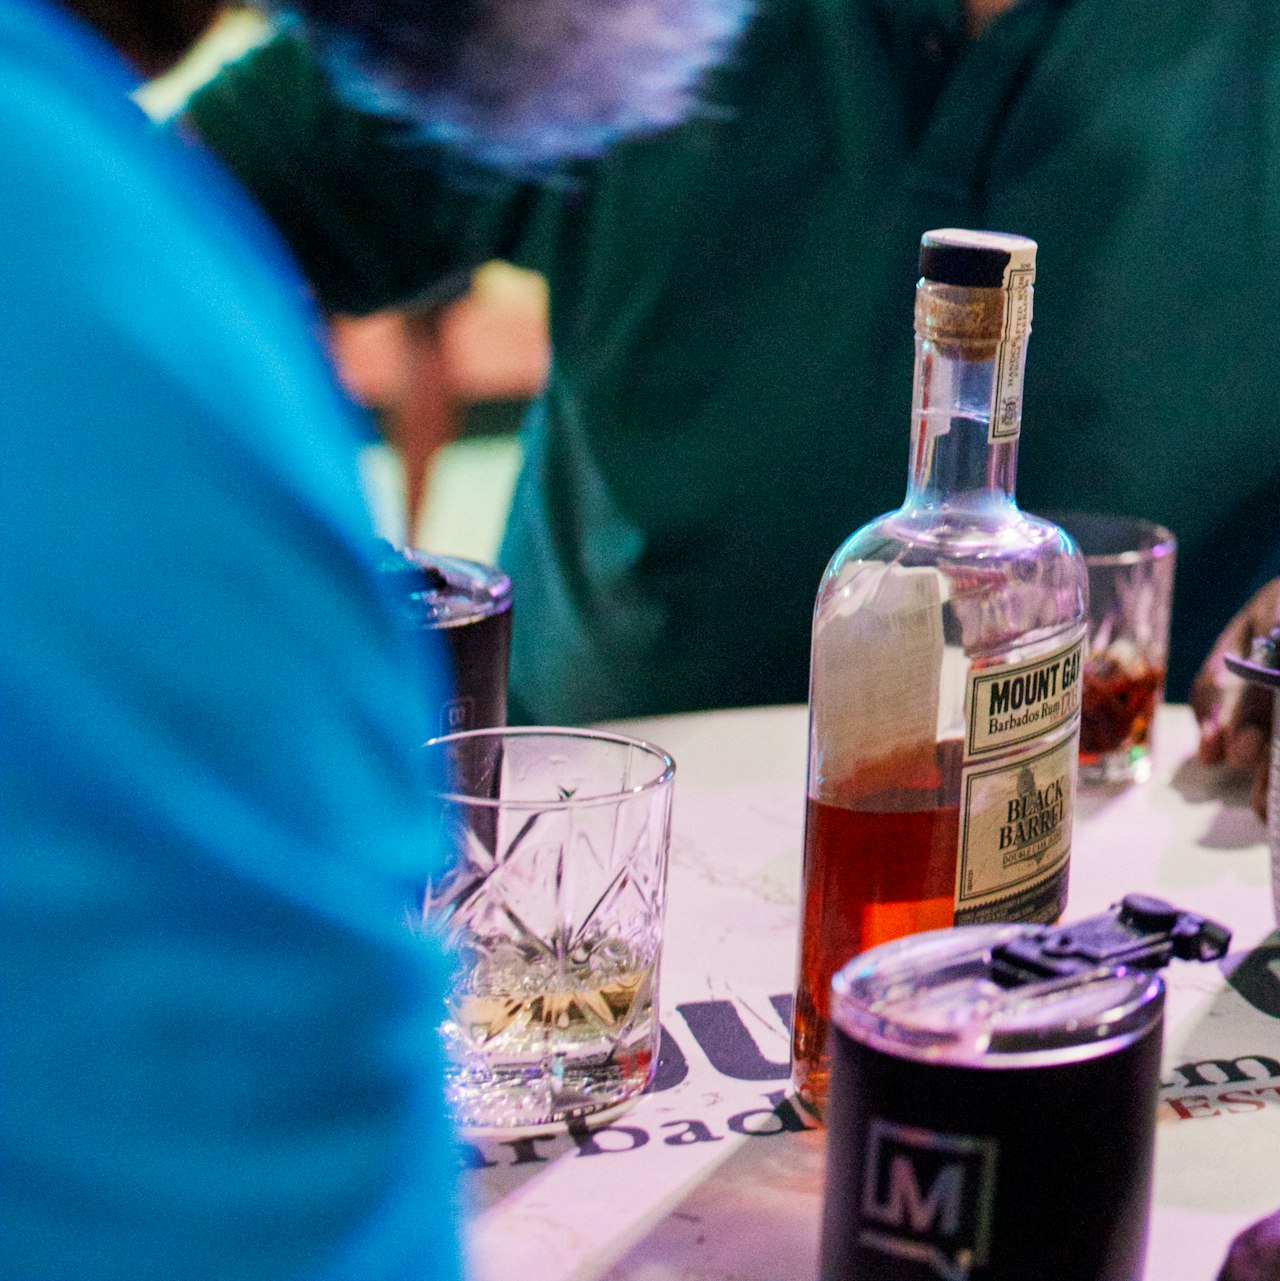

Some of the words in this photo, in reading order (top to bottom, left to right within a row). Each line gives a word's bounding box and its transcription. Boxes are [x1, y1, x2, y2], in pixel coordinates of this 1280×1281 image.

[989, 662, 1060, 716] MOUNT
[988, 708, 1040, 735] Barbados
[1041, 700, 1060, 719] Rum
[1008, 775, 1064, 822] BLACK
